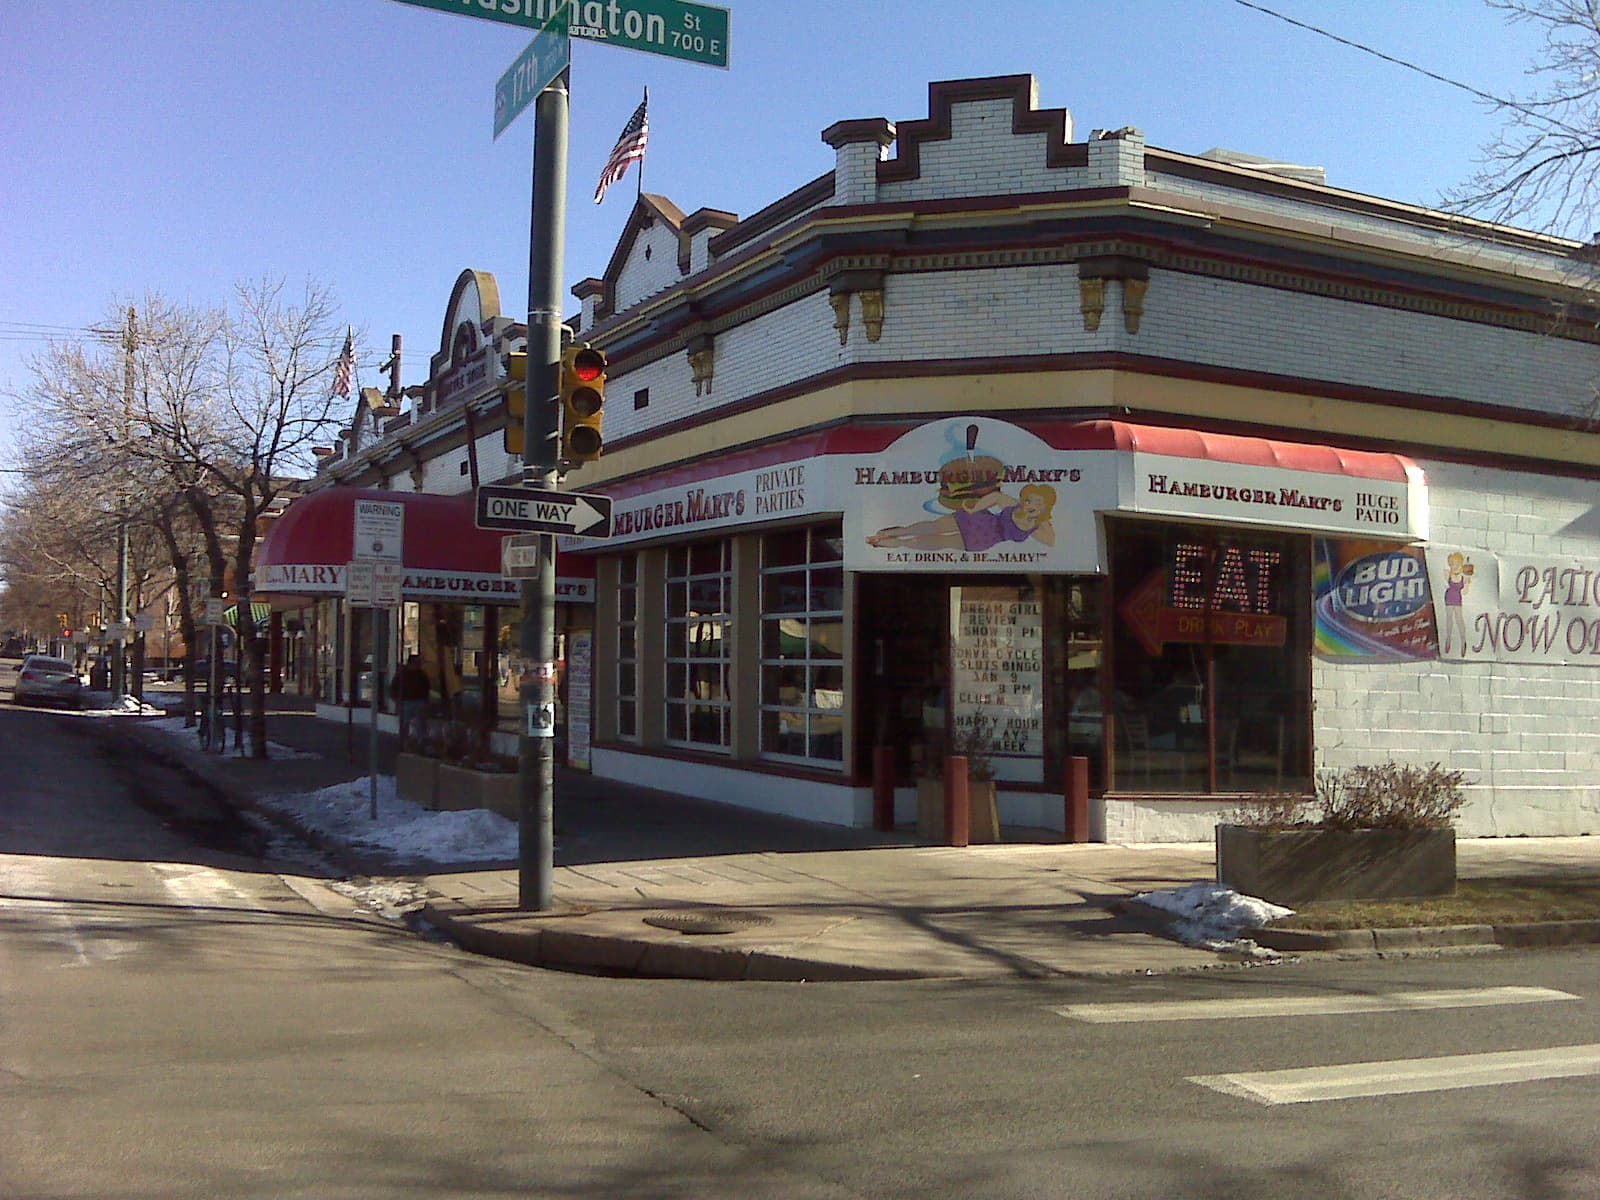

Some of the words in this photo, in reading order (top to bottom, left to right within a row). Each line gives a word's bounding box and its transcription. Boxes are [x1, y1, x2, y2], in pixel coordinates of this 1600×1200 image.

[683, 11, 701, 31] St
[671, 32, 704, 53] 700
[709, 40, 721, 56] E
[512, 53, 538, 108] 17th
[755, 465, 806, 493] PRIVATE
[1003, 464, 1081, 483] MARY'S
[755, 489, 806, 515] PARTIES
[1148, 474, 1278, 506] HAMBURGER
[1279, 487, 1344, 513] MARY'S
[1356, 492, 1399, 510] HUGE
[359, 503, 401, 518] WARNING
[492, 500, 529, 518] ONE
[536, 503, 573, 522] WAY
[613, 501, 685, 537] MBURGER
[686, 487, 746, 523] MARY'S
[1355, 507, 1399, 525] PATIO
[887, 552, 912, 564] EAT,
[915, 552, 957, 564] DRINK,
[960, 553, 969, 563] &
[1172, 543, 1281, 615] EAT
[1353, 557, 1419, 585] BUD
[402, 575, 516, 593] AMBURGER
[1343, 578, 1425, 607] LIGHT
[1009, 603, 1040, 615] GIRL
[969, 615, 1016, 625] REVIEW
[1235, 618, 1273, 640] PLAY
[964, 625, 997, 637] SHOW
[1472, 610, 1561, 655] NOW
[975, 638, 997, 649] JAN
[996, 649, 1040, 661] CYCLE
[1002, 661, 1041, 673] BINGO
[974, 672, 998, 683] JAN
[1014, 684, 1031, 695] PM
[956, 715, 998, 728] HAPPY
[1007, 718, 1039, 729] HOUR
